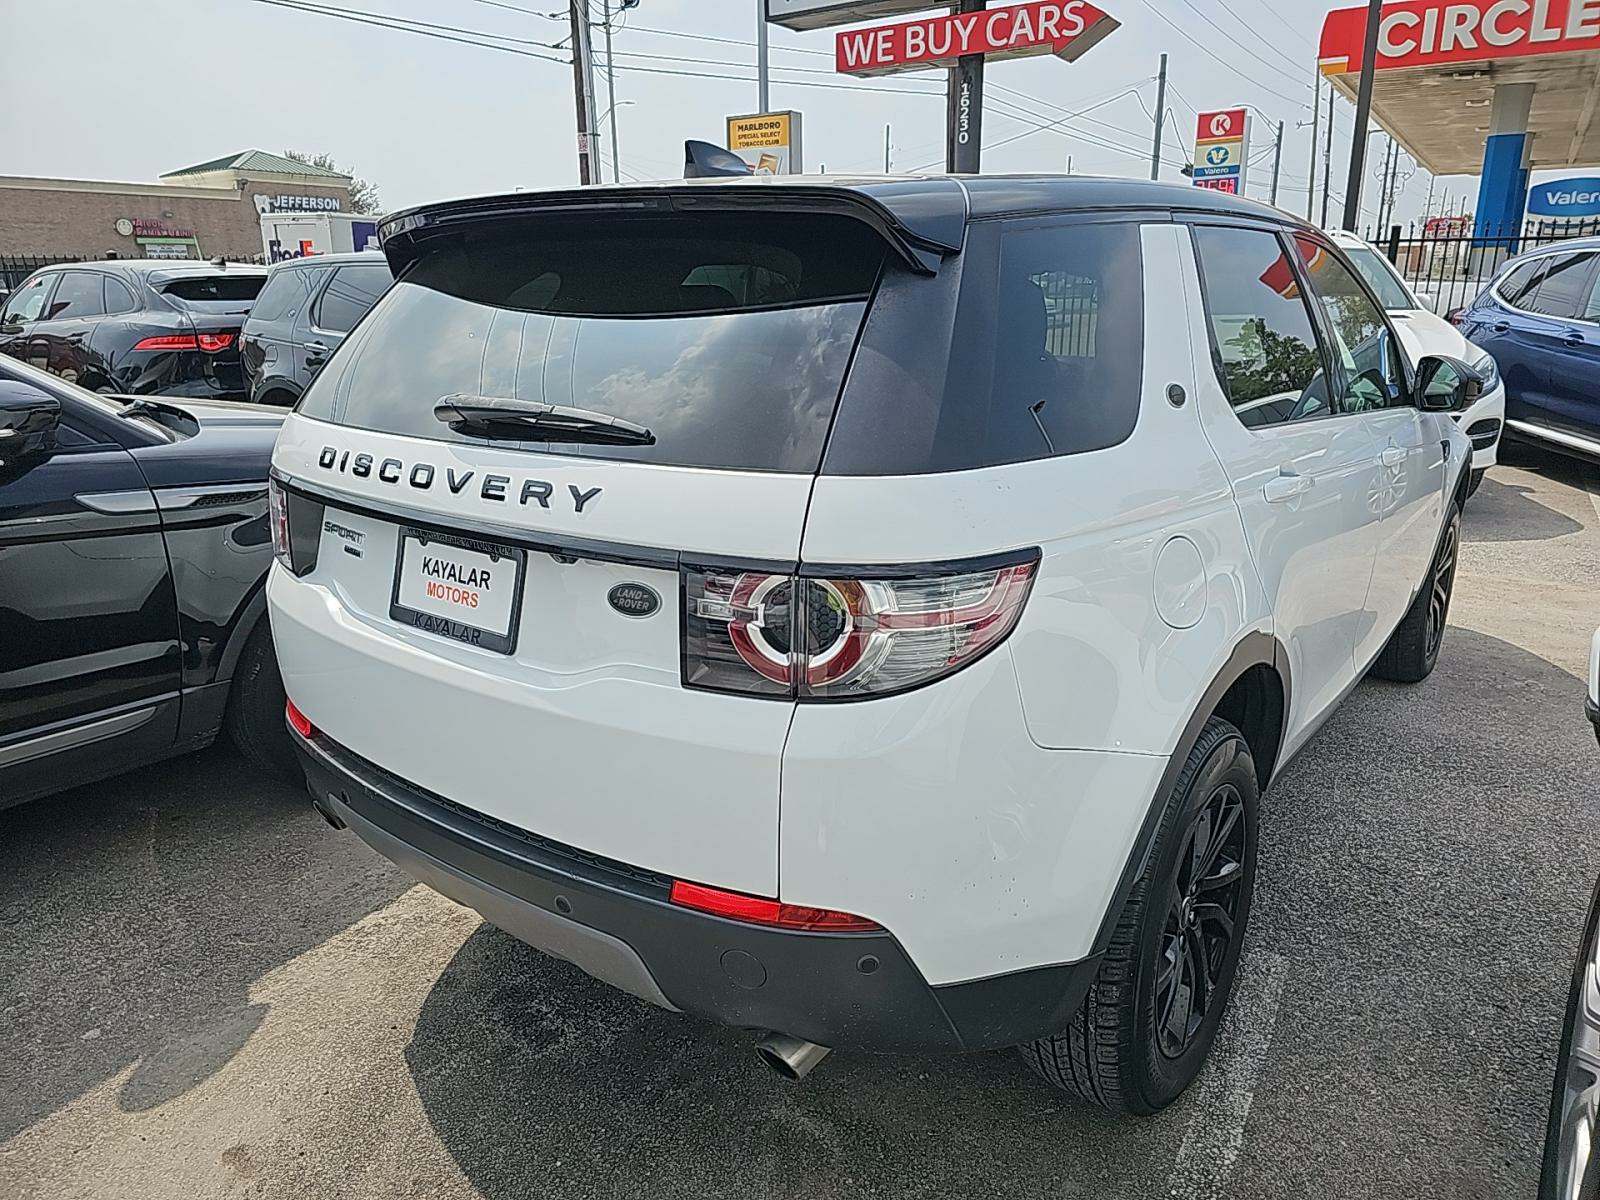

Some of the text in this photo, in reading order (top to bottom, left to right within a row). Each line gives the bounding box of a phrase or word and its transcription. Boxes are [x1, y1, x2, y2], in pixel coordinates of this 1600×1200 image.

[842, 1, 1085, 67] WE BUY CARS
[1376, 0, 1600, 58] CIRCLE
[958, 81, 970, 144] 16230
[737, 121, 781, 132] MARLBORO
[738, 138, 780, 148] TOBACCO CLUB
[1204, 166, 1229, 175] Valero
[273, 195, 340, 210] JEFFERSON
[1547, 189, 1600, 205] Valer
[318, 445, 603, 513] DISCOVERY
[324, 520, 366, 544] SPORT
[421, 556, 491, 591] KAYALAR
[426, 581, 479, 608] MOTORS
[412, 611, 481, 646] KAYALAR
